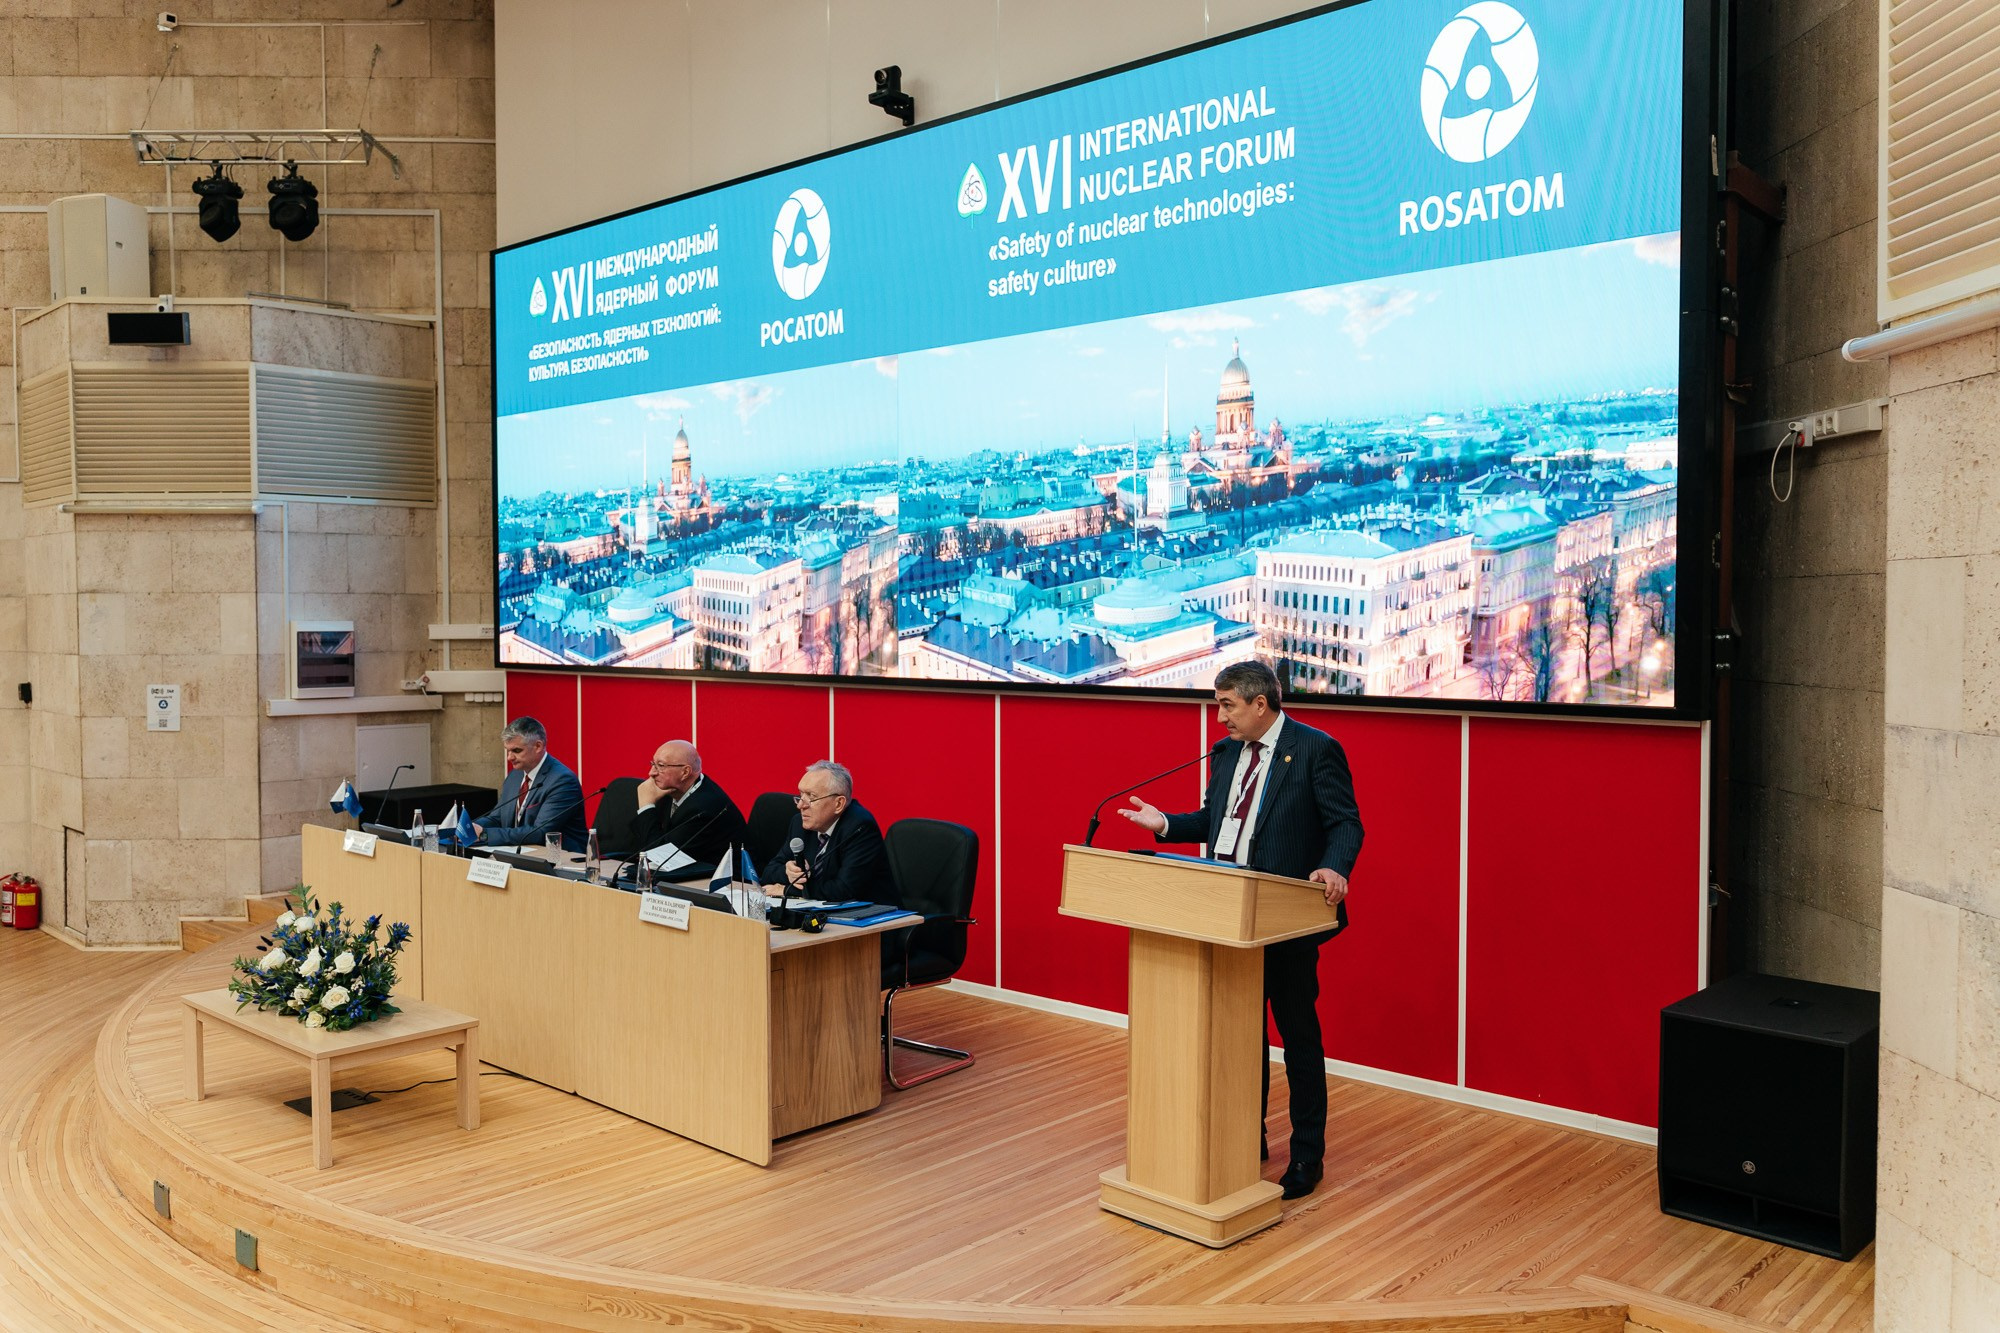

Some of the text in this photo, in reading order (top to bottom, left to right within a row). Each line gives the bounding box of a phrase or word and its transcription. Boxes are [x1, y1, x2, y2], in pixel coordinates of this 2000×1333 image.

[1079, 86, 1276, 161] INTERNATIONAL
[996, 135, 1072, 223] XVI
[1079, 127, 1295, 204] NUCLEAR FORUM
[988, 181, 1295, 261] «Safety of nuclear technologies:
[1399, 172, 1565, 236] ROSATOM
[595, 223, 719, 280] МЕЖДУНАРОДНЫЙ
[988, 257, 1117, 297] safety culture»
[551, 261, 594, 324] XVI
[595, 265, 719, 316] ЯДЕРНЫЙ ФОРУМ
[528, 303, 722, 361] «БЕЗОПАСНОСТЬ ЯДЕРНЫХ ТЕХНОЛОГИЙ:
[760, 308, 844, 348] РОСАТОМ
[528, 348, 649, 382] КУЛЬТУРА БЕЗОПАСНОСТИ»
